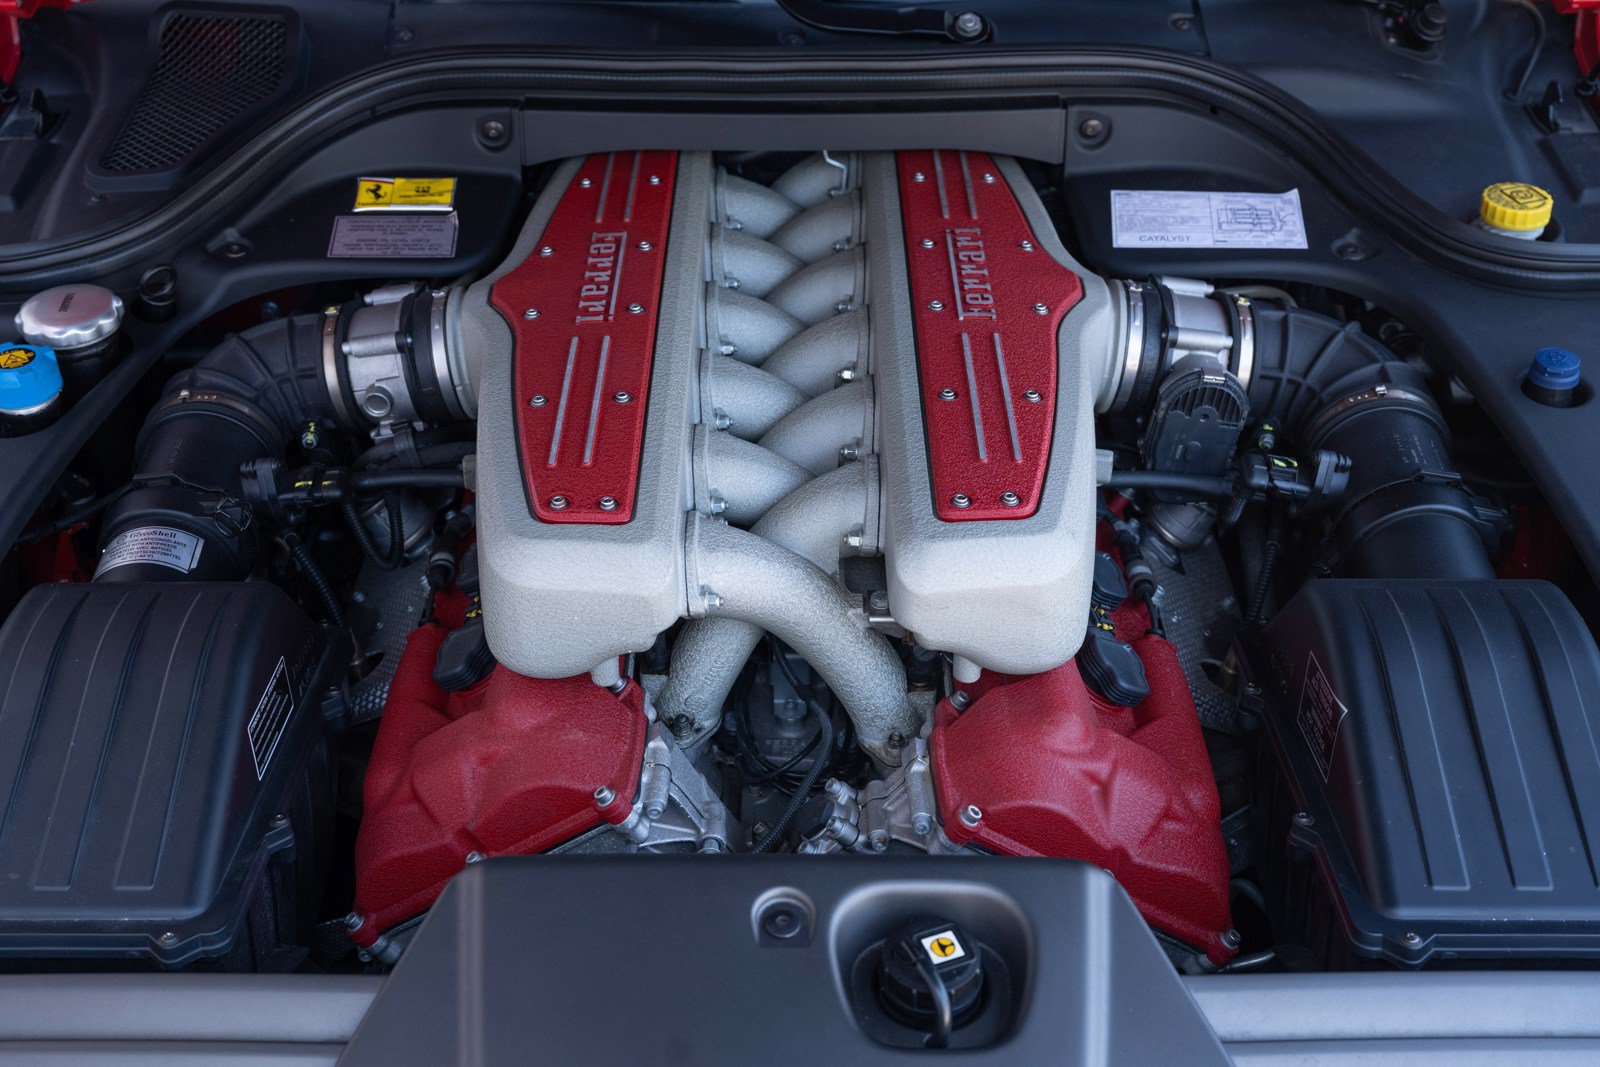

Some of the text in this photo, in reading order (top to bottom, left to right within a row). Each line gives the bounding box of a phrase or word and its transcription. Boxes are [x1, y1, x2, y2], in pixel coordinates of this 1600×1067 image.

[1138, 234, 1191, 243] CATALYST
[575, 230, 628, 326] Ferrari
[945, 227, 997, 321] Ferrari
[130, 530, 177, 539] GlycoShell
